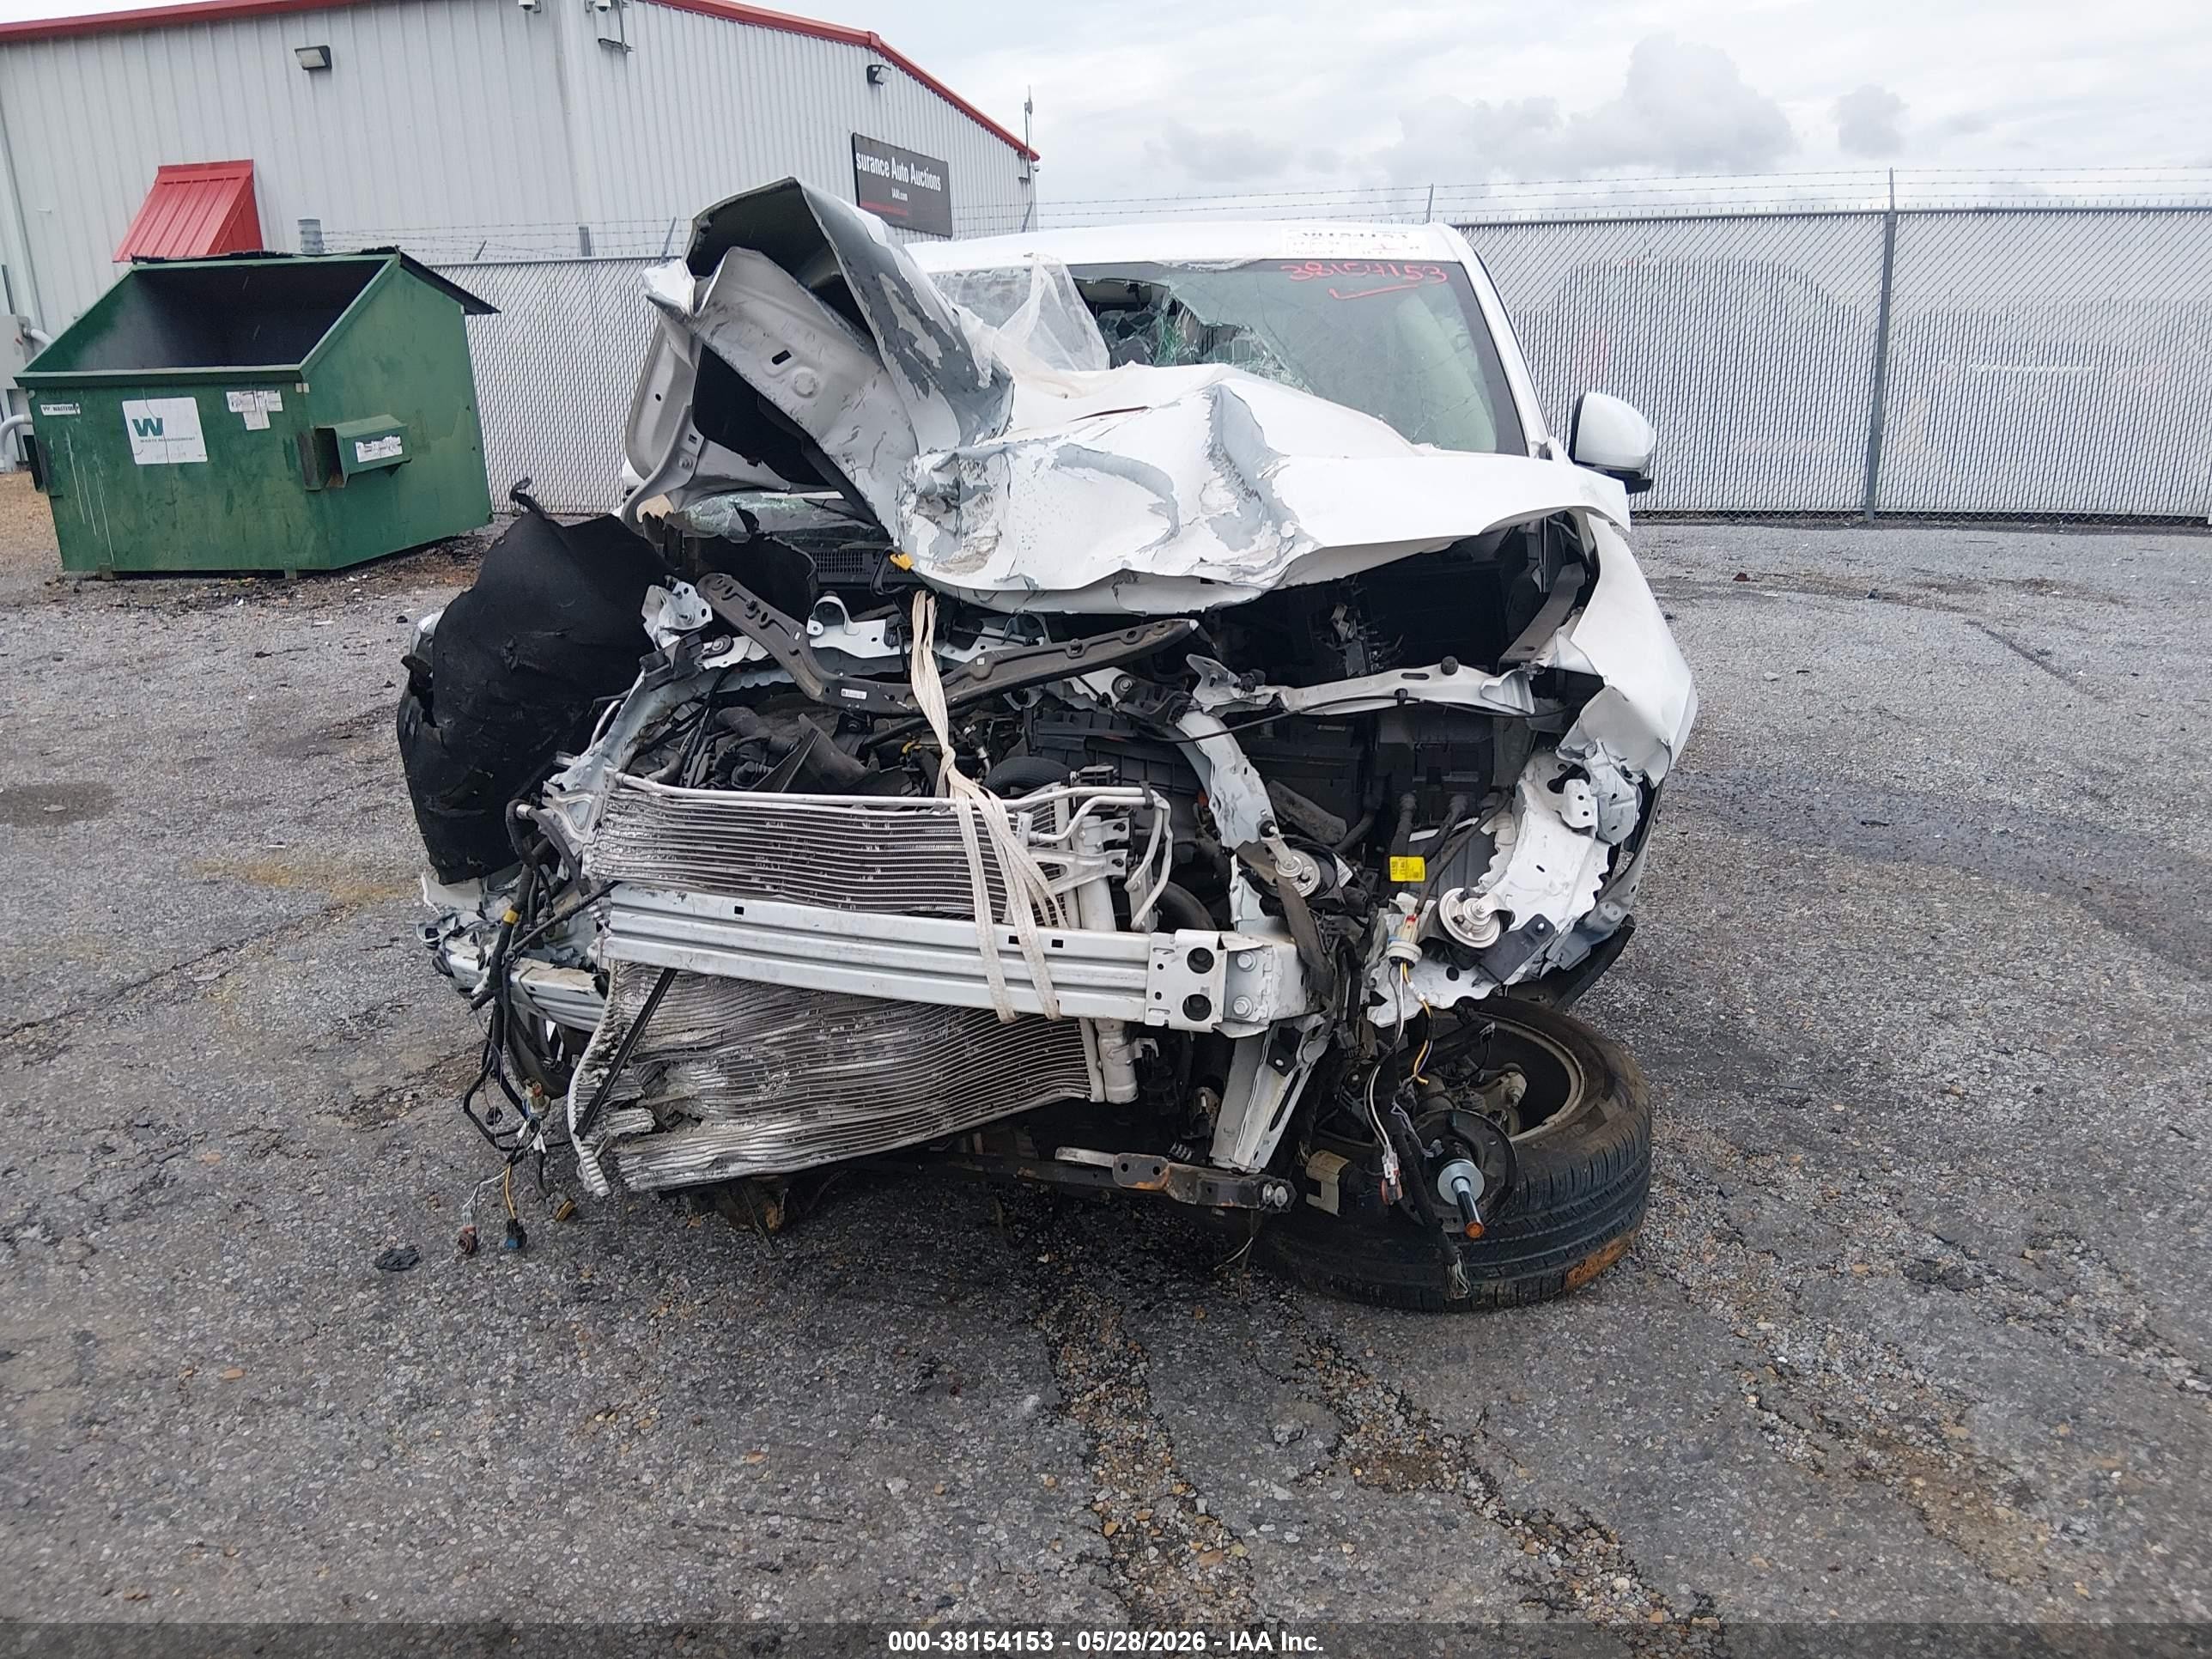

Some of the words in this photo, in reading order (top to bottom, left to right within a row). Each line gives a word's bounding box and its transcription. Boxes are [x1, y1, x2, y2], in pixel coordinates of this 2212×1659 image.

[892, 158, 909, 183] Auto
[910, 162, 941, 191] Auctions
[131, 417, 163, 437] W
